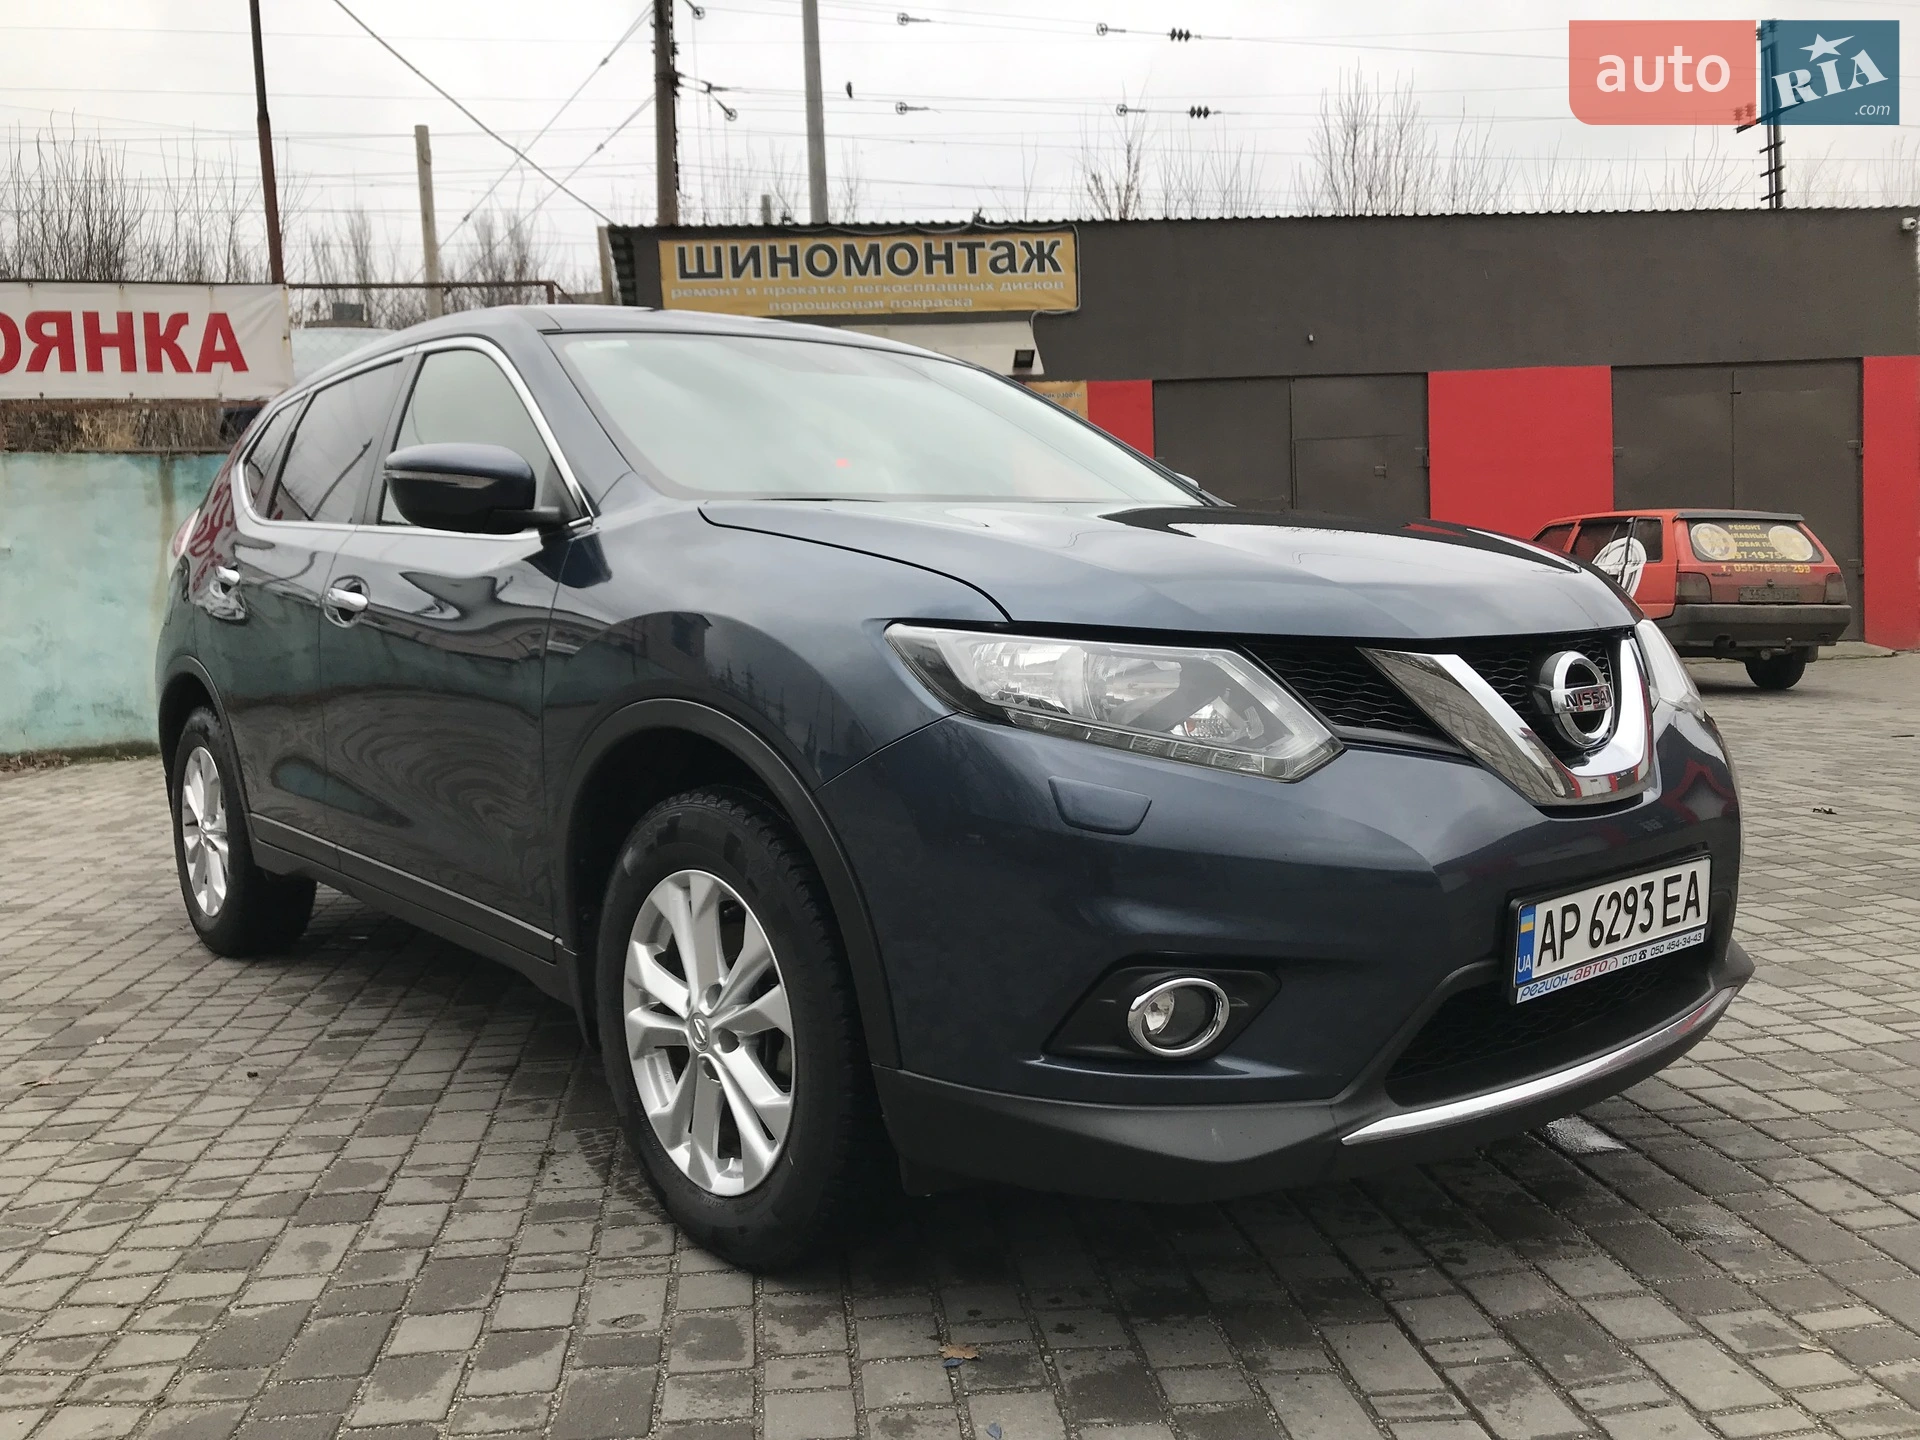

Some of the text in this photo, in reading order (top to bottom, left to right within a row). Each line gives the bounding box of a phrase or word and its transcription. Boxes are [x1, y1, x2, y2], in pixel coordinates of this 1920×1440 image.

[671, 280, 1065, 300] ремонт и прокатка легкосплавных дисков
[769, 298, 973, 313] порошковая покраска
[1536, 870, 1702, 967] AP 6293 EA
[1650, 943, 1665, 956] 050
[1517, 955, 1532, 974] UA
